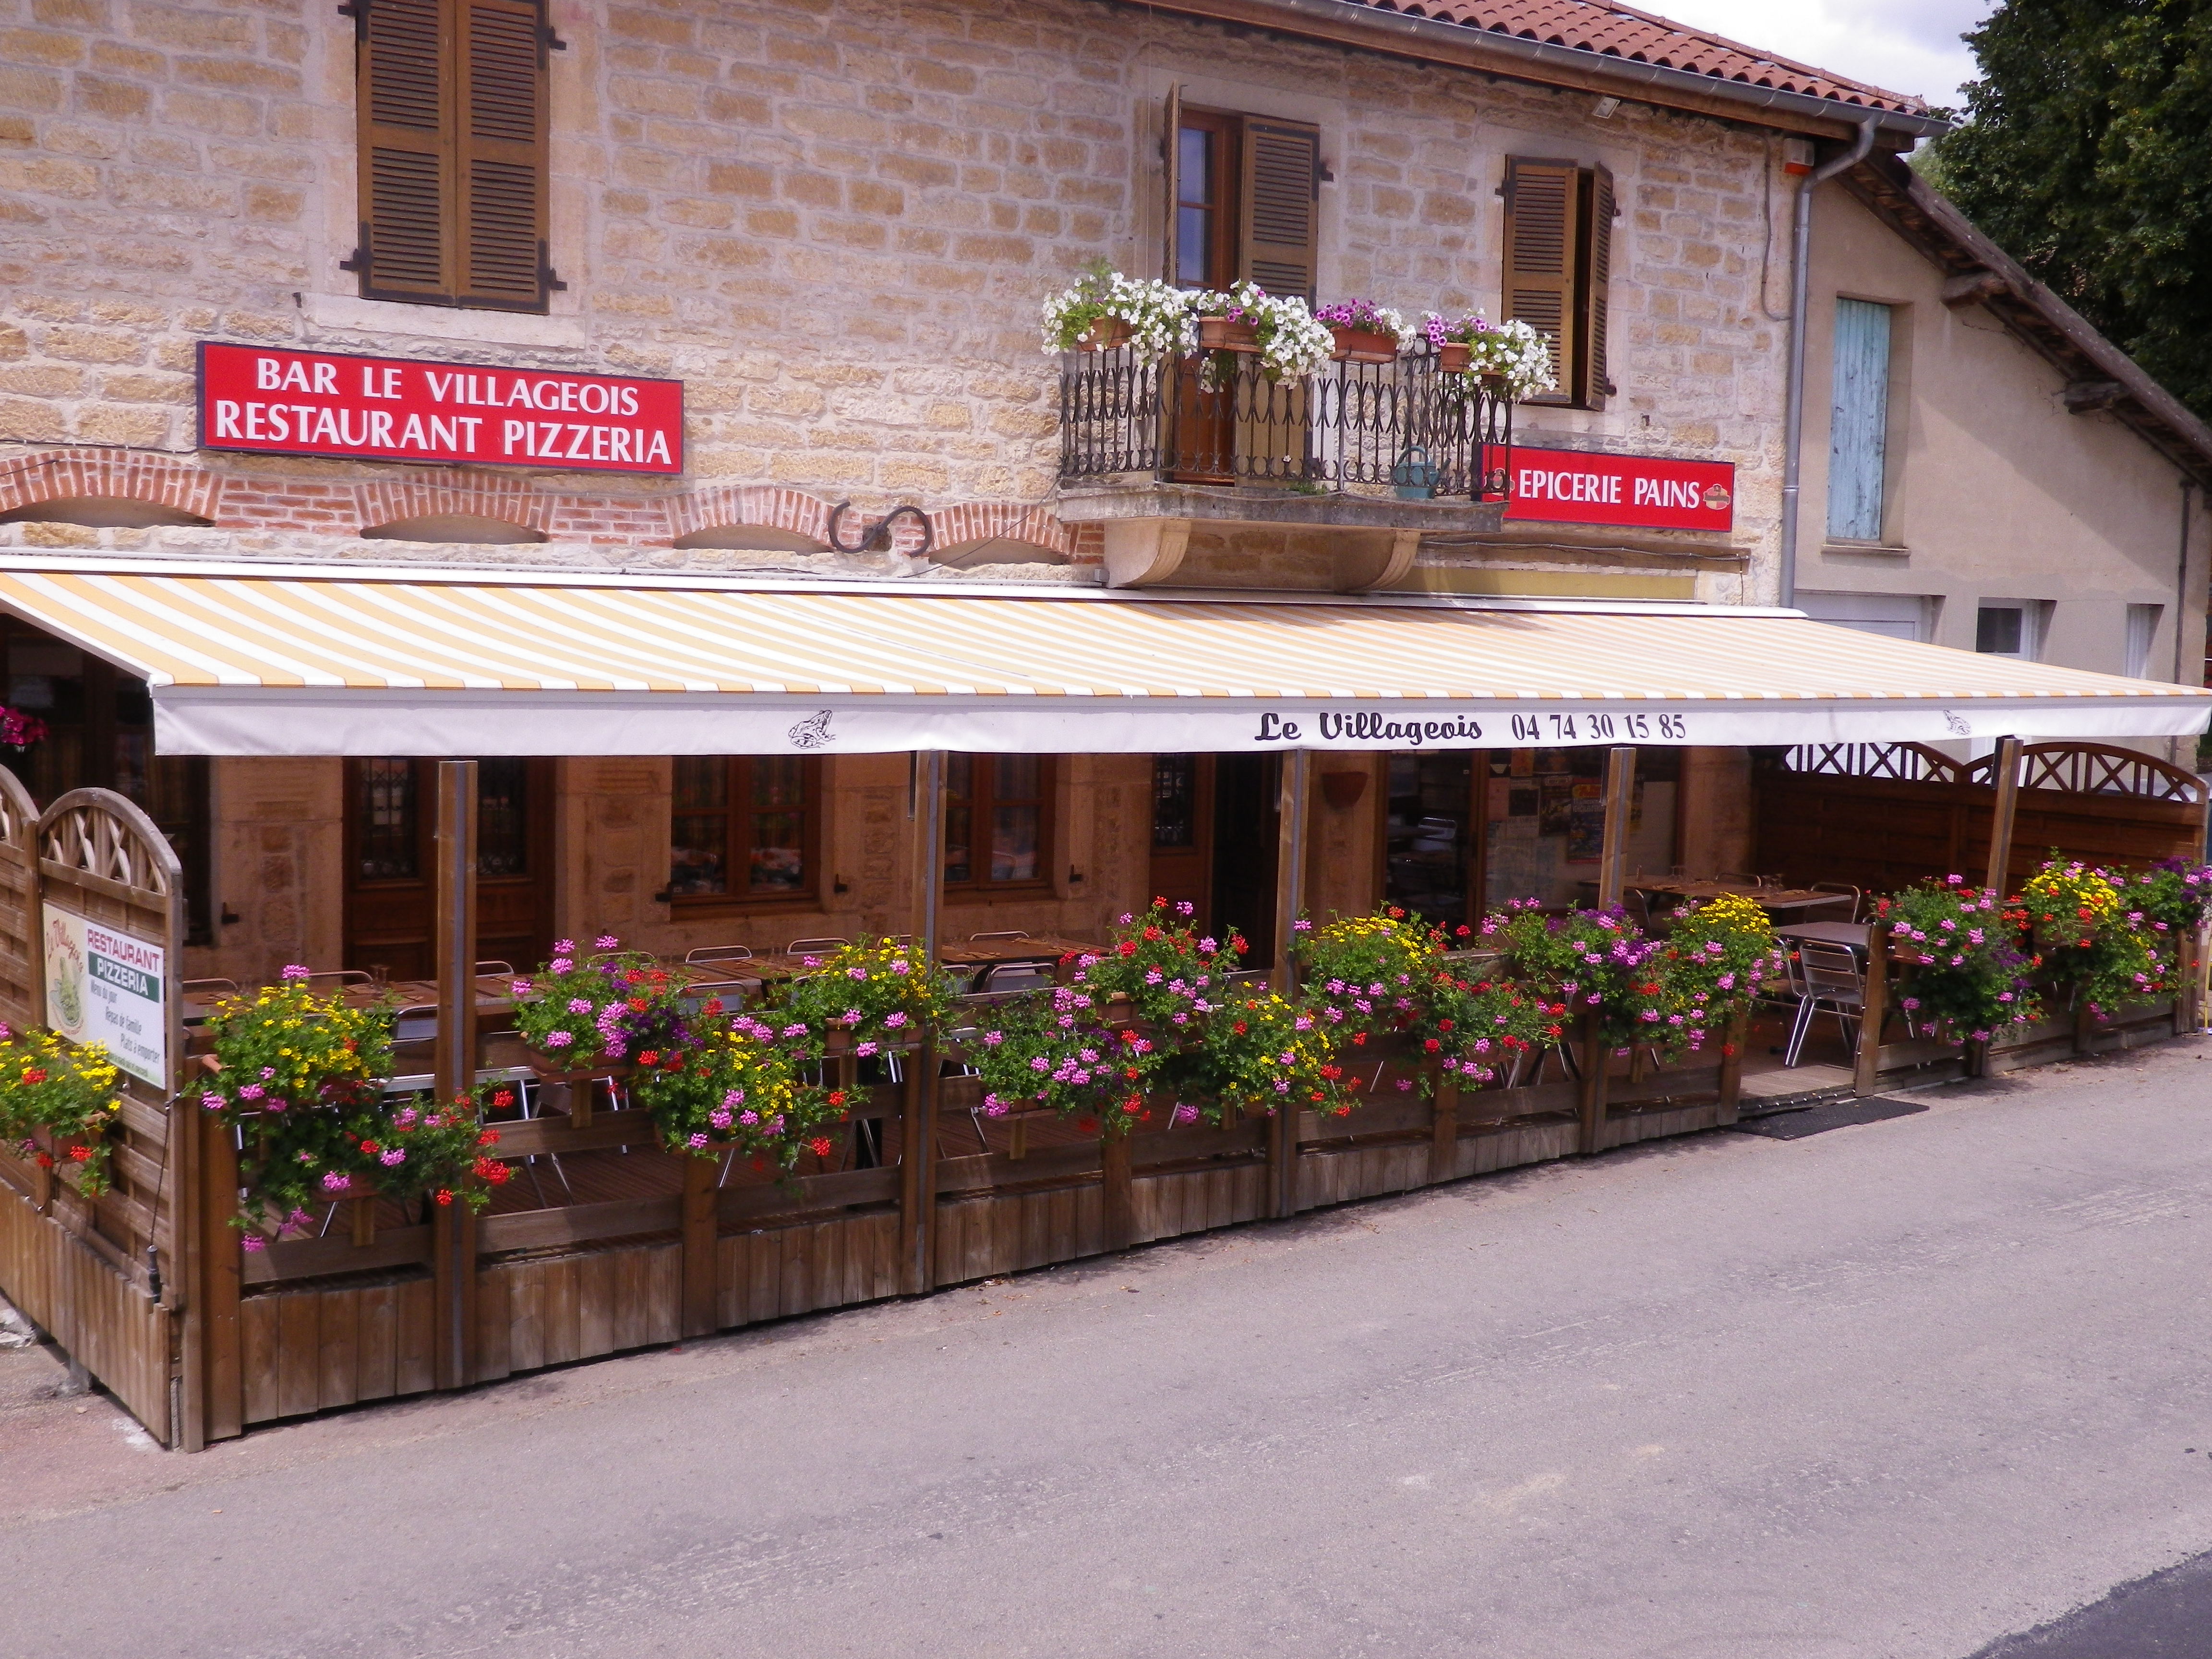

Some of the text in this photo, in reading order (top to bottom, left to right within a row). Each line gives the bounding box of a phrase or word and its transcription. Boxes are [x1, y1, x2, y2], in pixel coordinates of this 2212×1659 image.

[257, 358, 638, 416] BAR LE VILLAGEOIS
[216, 400, 672, 465] RESTAURANT PIZZERIA
[1519, 469, 1699, 508] EPICERIE PAINS
[1254, 712, 1686, 745] Le Villageois 04 74 30 15 85
[88, 929, 159, 972] RESTAURANT
[97, 958, 148, 996] PIZZERIA
[120, 1033, 132, 1051] Plats
[137, 1045, 160, 1063] emporter
